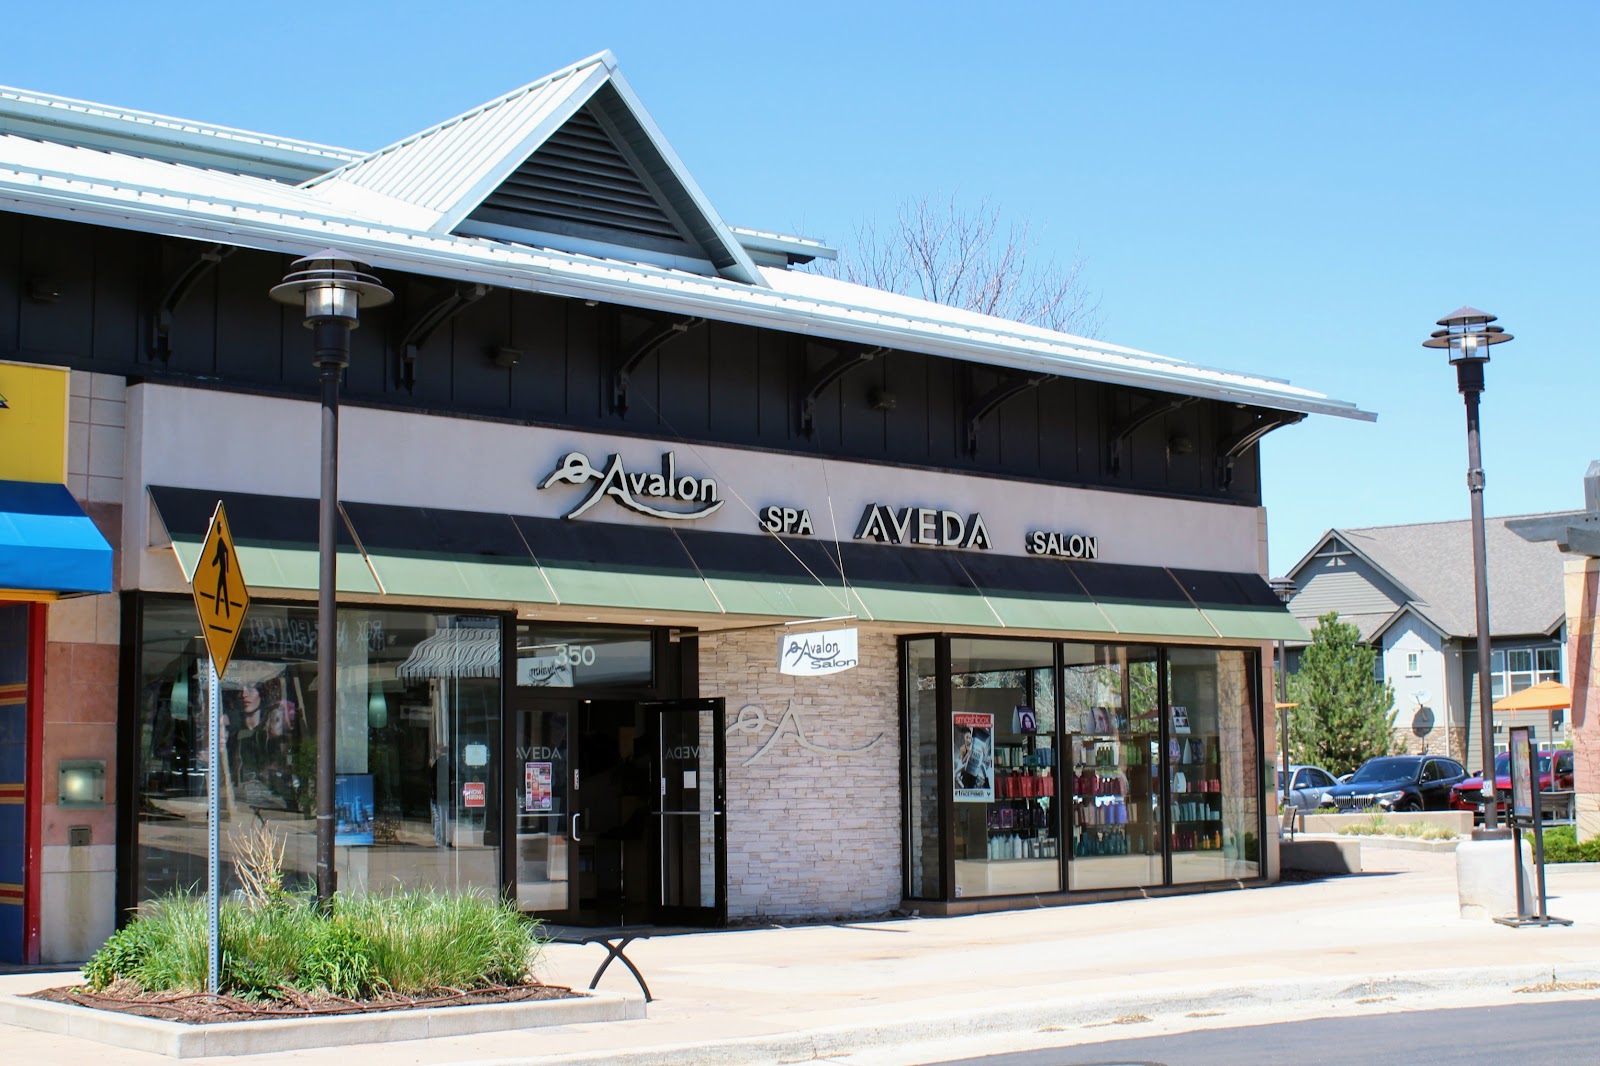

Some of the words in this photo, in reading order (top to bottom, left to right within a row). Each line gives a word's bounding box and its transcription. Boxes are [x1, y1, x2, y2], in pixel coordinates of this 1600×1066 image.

[560, 451, 725, 519] Avalon
[761, 506, 815, 535] SPA
[854, 503, 993, 549] AVEDA
[1027, 530, 1098, 559] SALON
[555, 645, 596, 666] 350
[792, 635, 840, 667] Avalon
[811, 659, 857, 670] Salon
[955, 714, 990, 725] smashbox
[516, 747, 561, 759] AVEDA
